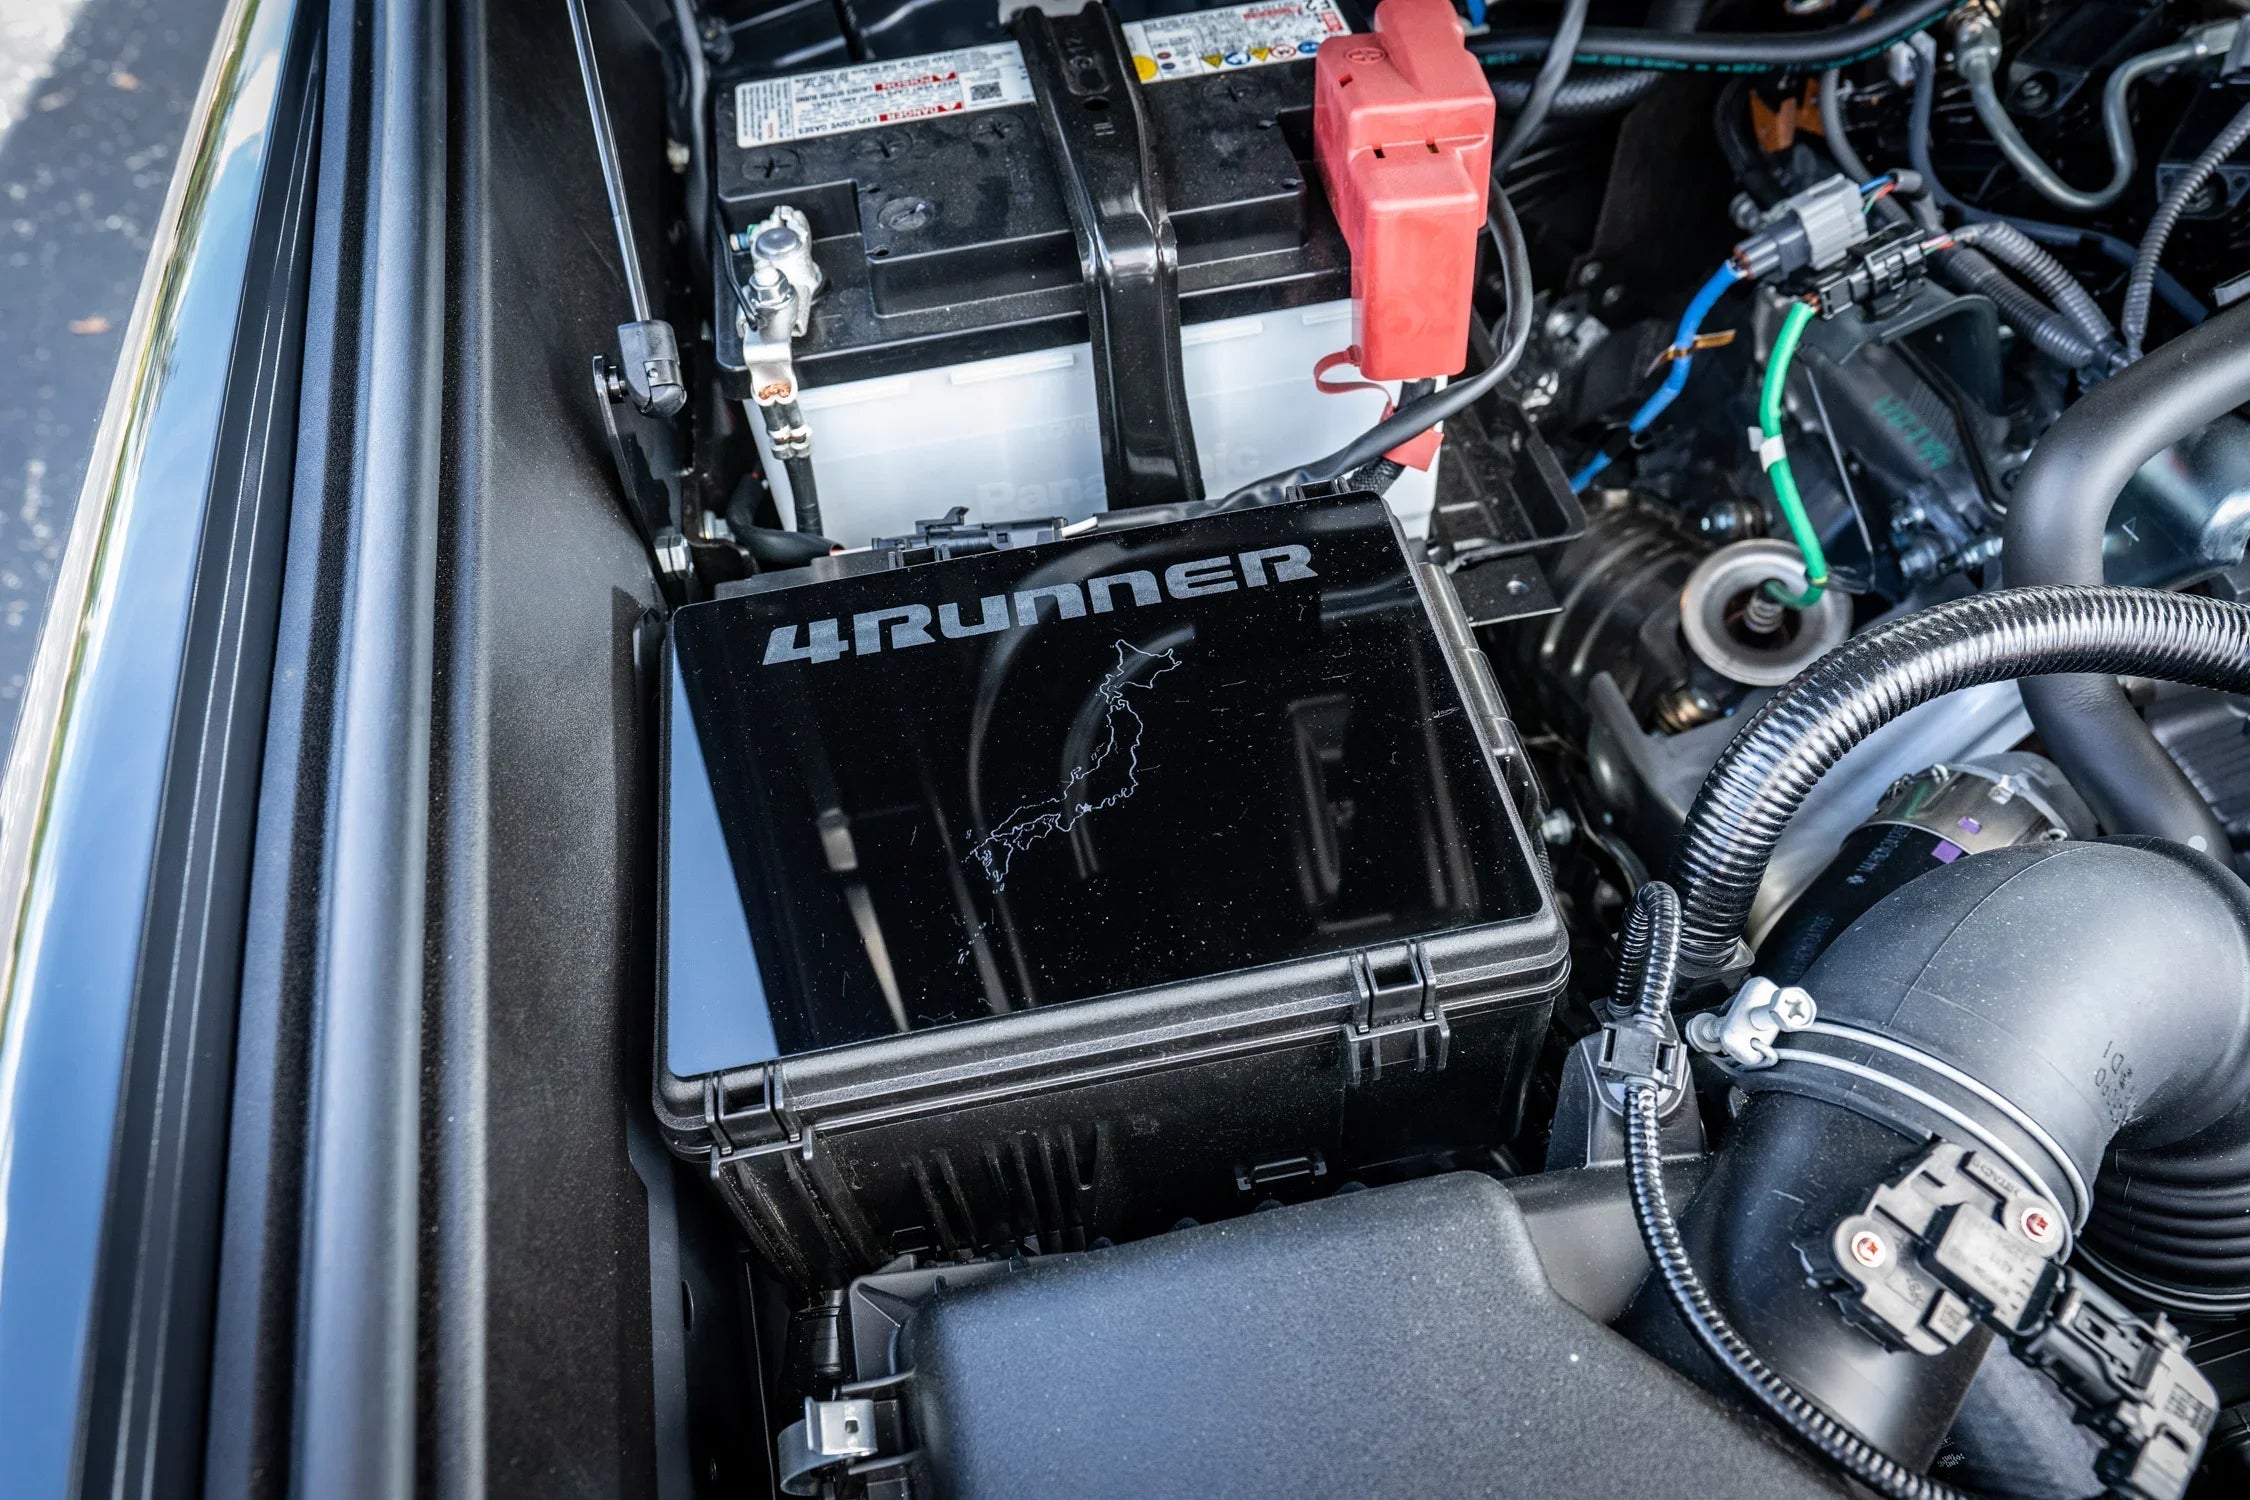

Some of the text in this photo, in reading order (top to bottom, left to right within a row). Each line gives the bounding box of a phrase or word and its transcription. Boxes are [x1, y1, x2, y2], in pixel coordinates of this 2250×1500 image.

[883, 76, 930, 89] POISON
[888, 106, 937, 120] DANGER
[797, 116, 877, 134] EXPLOSIVE GASES
